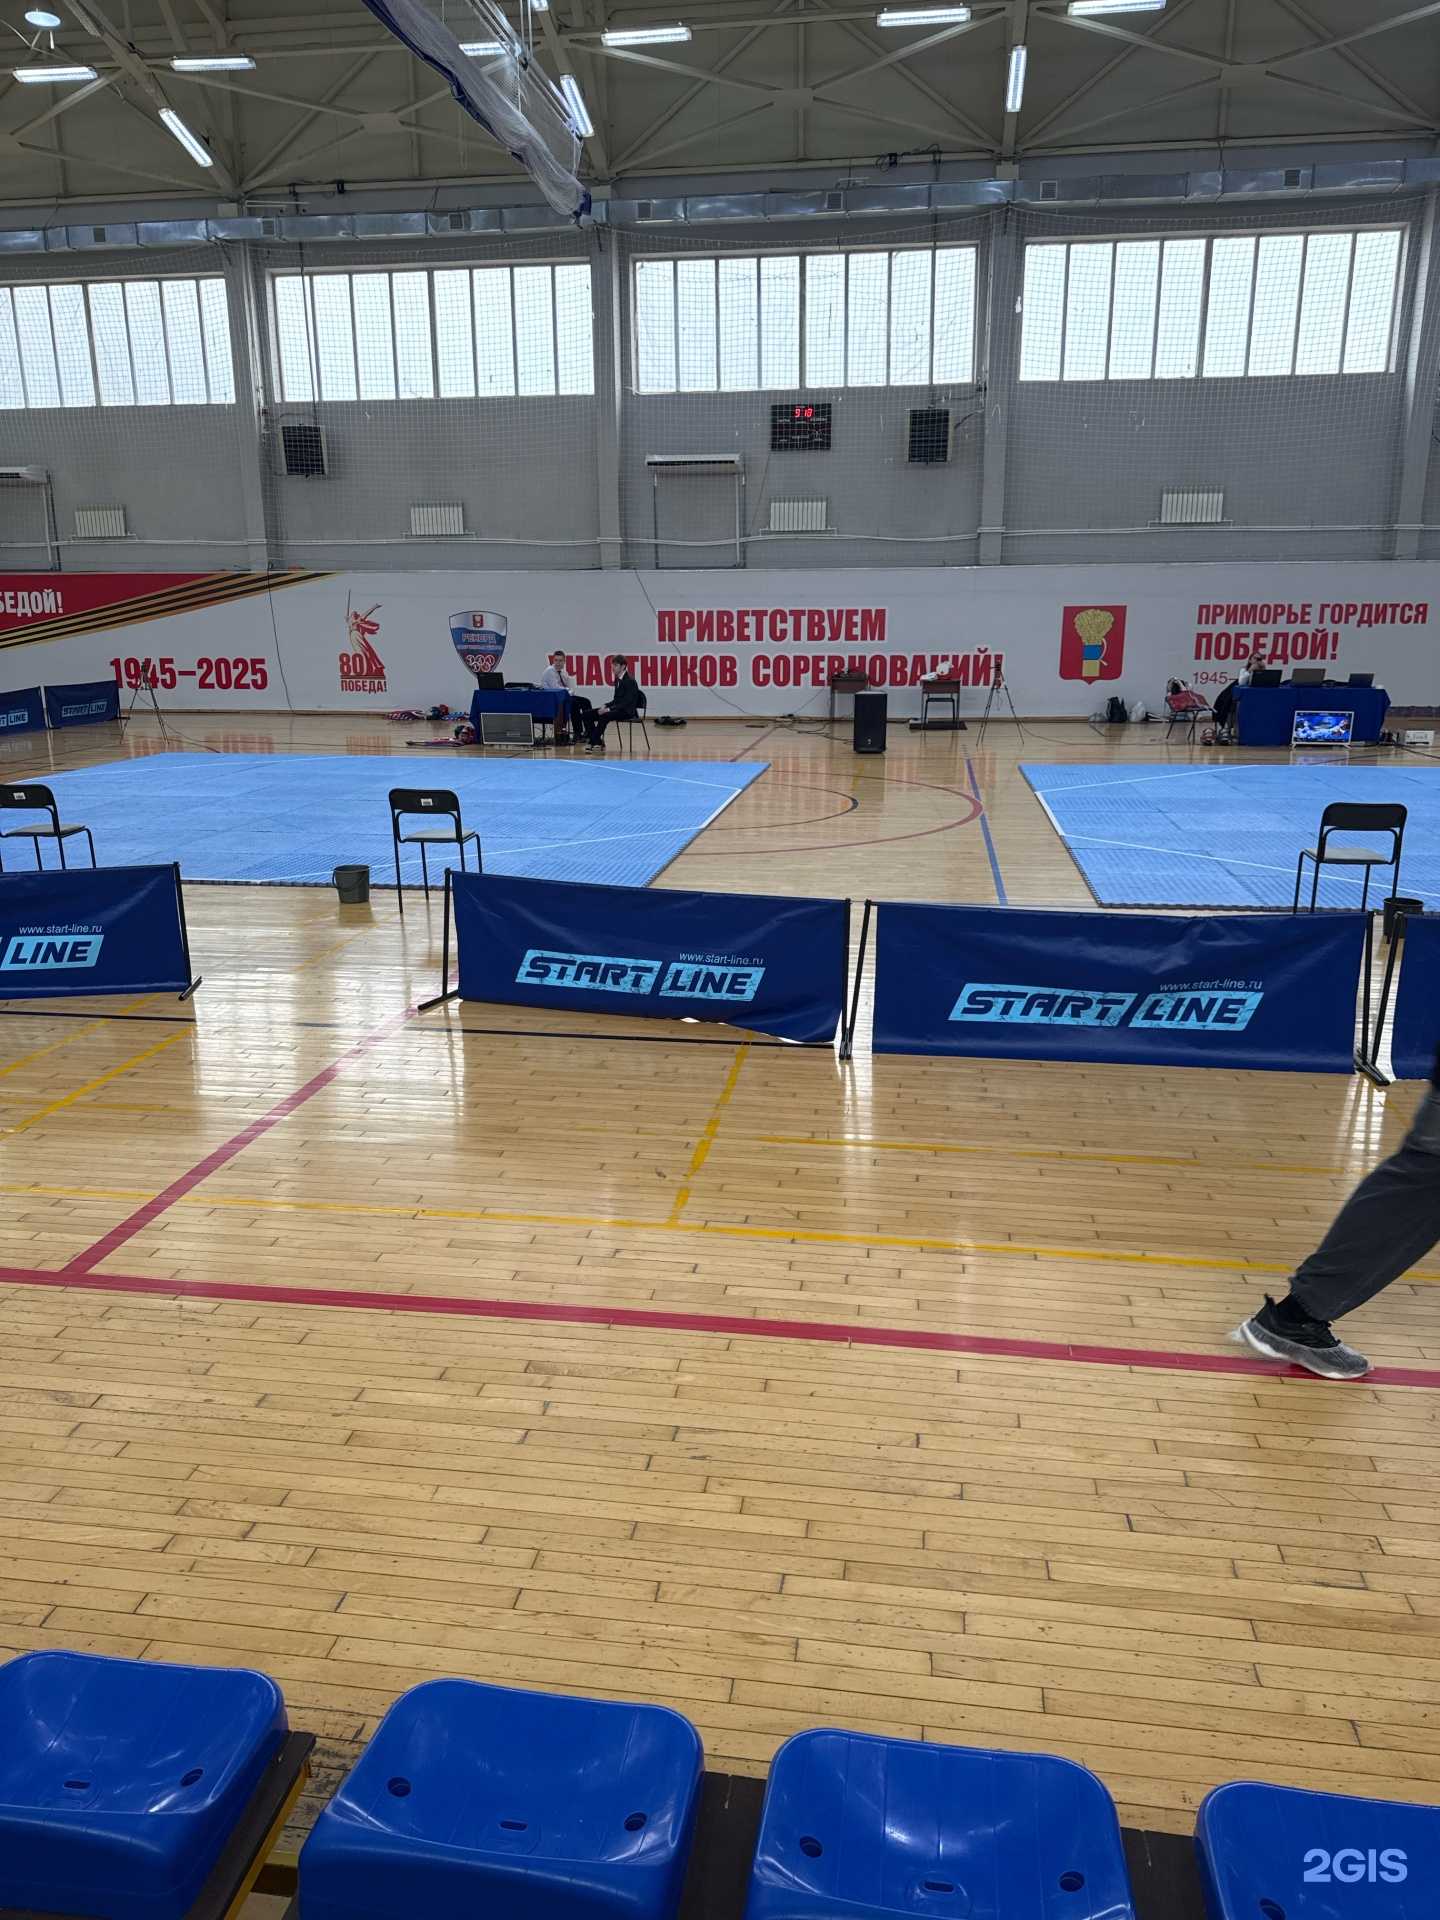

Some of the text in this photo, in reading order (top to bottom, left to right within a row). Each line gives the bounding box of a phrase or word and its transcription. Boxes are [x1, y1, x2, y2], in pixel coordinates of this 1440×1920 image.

[657, 608, 886, 642] ПРИВЕТСТВУЕМ
[1197, 603, 1428, 628] ПРИМОРЬЕ ГОРДИТСЯ
[1194, 628, 1339, 665] ПОБЕДОЙ!
[339, 653, 364, 676] 80
[341, 680, 388, 694] ПОБЕДА!
[19, 923, 103, 934] www.start-line.ru
[9, 941, 93, 965] LINE
[679, 952, 764, 965] www.start-line.ru
[525, 956, 753, 995] START LINE
[1159, 977, 1263, 991] www.start-line.ru
[960, 990, 1248, 1024] START LINE
